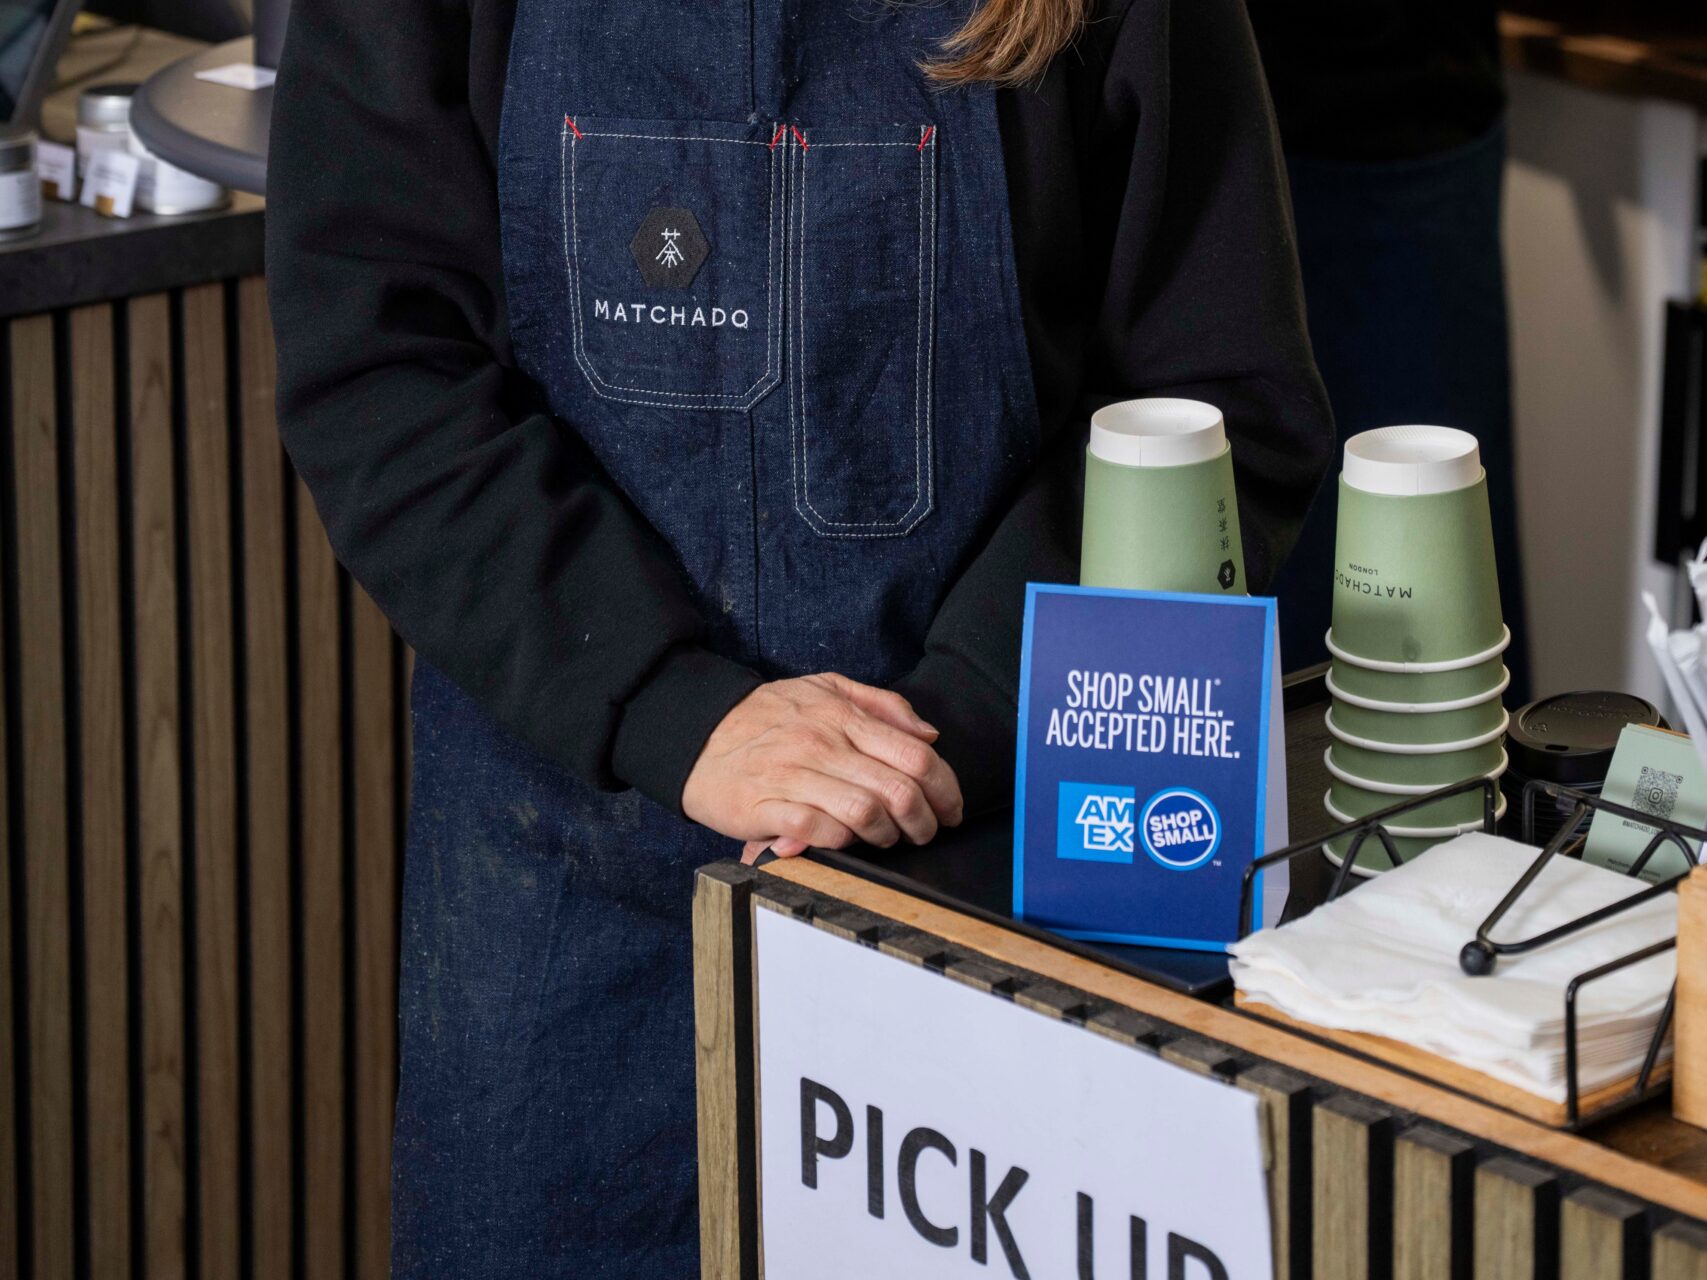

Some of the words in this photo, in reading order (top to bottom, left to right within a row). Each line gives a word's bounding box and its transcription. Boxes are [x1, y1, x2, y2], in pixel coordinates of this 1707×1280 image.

[1336, 569, 1412, 598] MATCHAD
[1349, 563, 1378, 576] LONDON
[1066, 670, 1133, 710] SHOP
[1046, 708, 1167, 753] ACCEPTED
[1173, 717, 1240, 758] HERE.
[1149, 810, 1203, 832] SHOP
[1153, 825, 1213, 848] SMALL
[800, 1076, 1031, 1280] PICK
